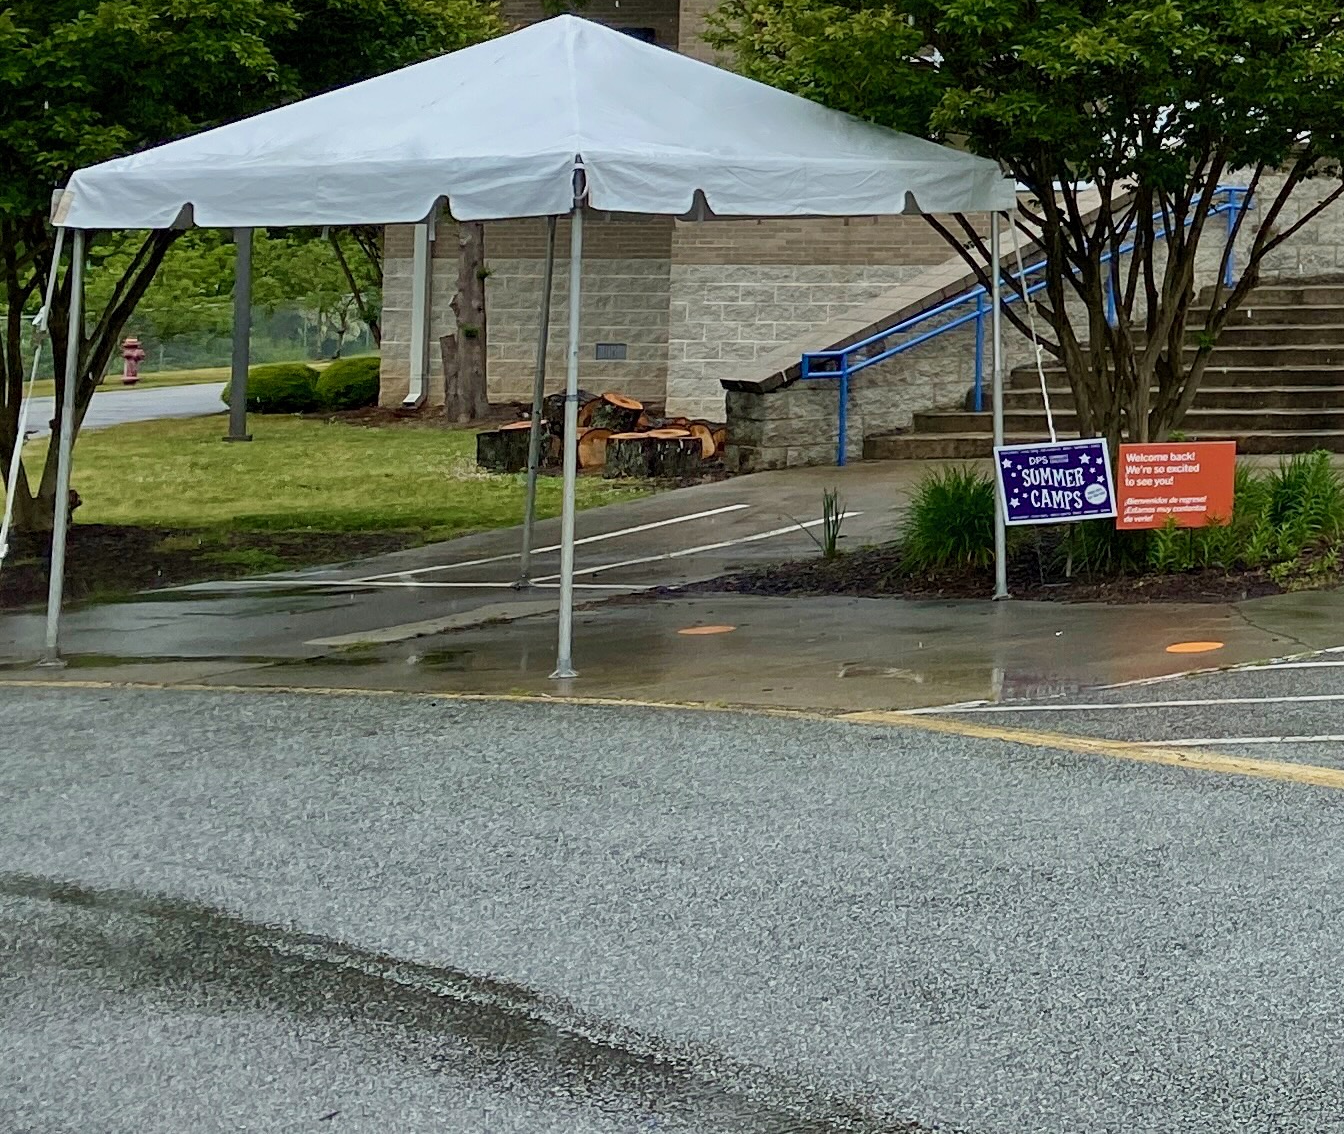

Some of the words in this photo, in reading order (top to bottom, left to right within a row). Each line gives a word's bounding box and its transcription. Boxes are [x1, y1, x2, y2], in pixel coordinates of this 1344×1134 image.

[1028, 456, 1049, 466] DPS
[1126, 453, 1169, 462] Welcome
[1170, 451, 1196, 461] back!
[1125, 465, 1152, 474] We're
[1153, 466, 1165, 474] so
[1166, 463, 1200, 473] excited
[1021, 467, 1086, 487] SUMMER
[1125, 477, 1135, 486] to
[1136, 478, 1153, 486] see
[1154, 476, 1174, 487] you!
[1030, 488, 1083, 510] CAMPS
